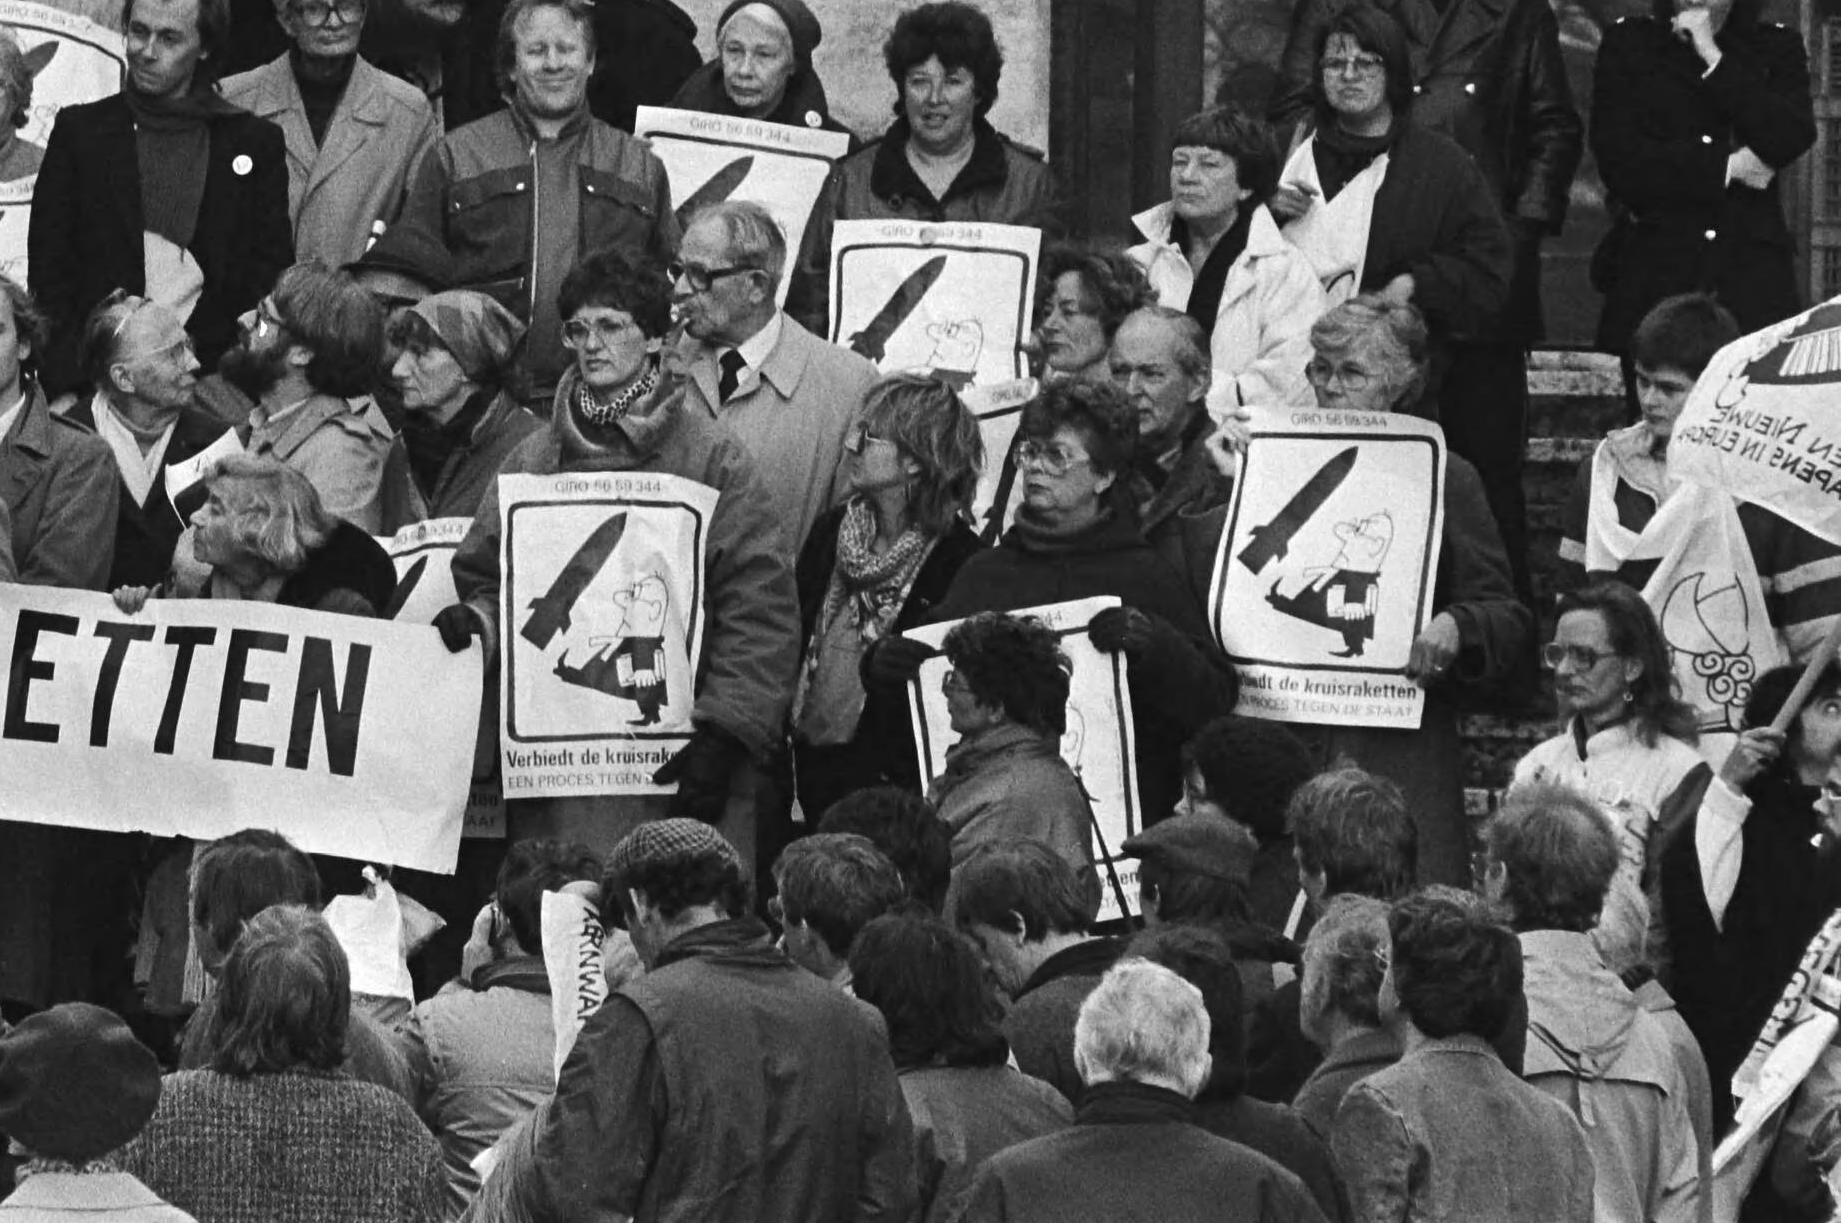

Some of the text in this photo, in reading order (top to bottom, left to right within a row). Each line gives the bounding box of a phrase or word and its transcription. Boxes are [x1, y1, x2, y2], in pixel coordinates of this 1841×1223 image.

[1278, 676, 1299, 691] de
[1303, 678, 1418, 700] kruisraketten
[506, 745, 679, 769] Verbiedt de kruisrak
[508, 775, 535, 789] EEN
[538, 773, 595, 788] PROCES
[598, 771, 643, 787] TEGEN
